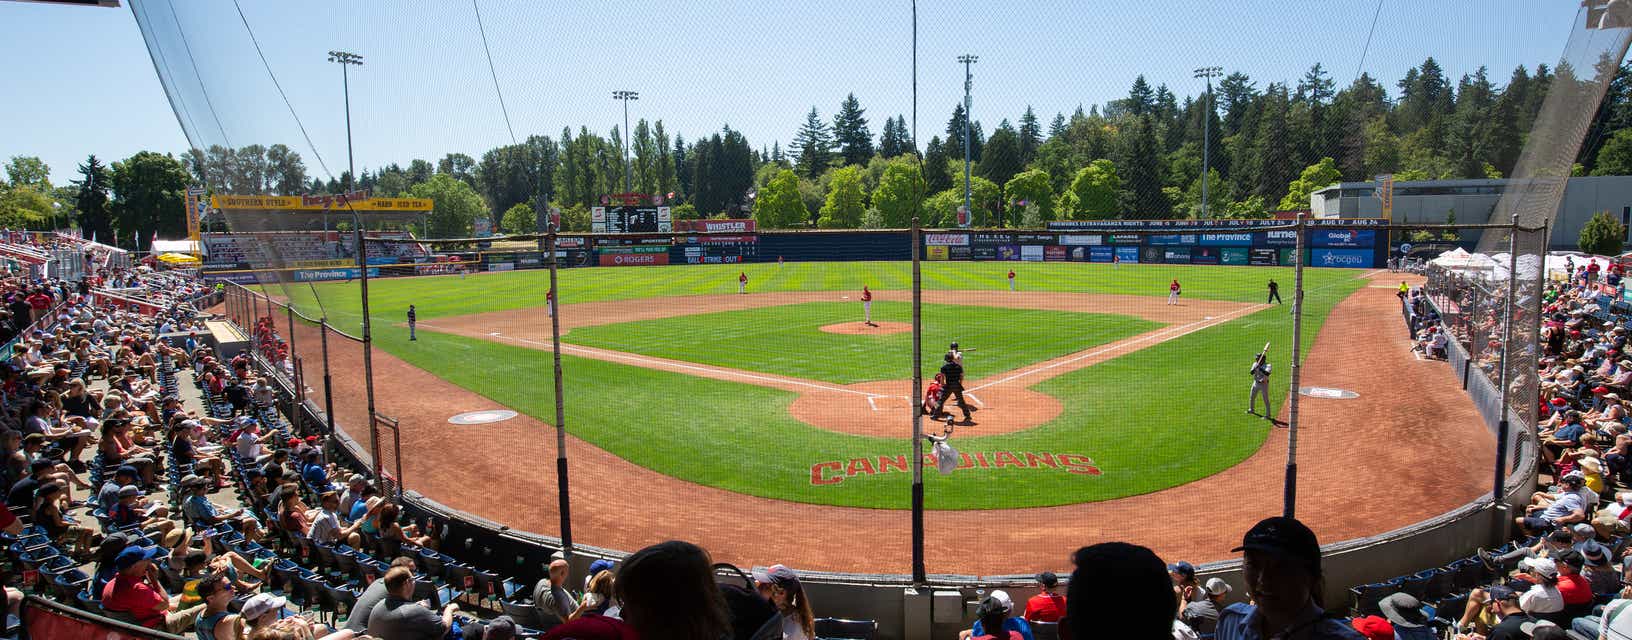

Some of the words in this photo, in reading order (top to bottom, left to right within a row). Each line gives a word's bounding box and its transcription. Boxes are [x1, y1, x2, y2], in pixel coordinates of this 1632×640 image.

[705, 222, 745, 231] WHISTLER
[300, 271, 314, 279] The
[315, 270, 347, 279] Province
